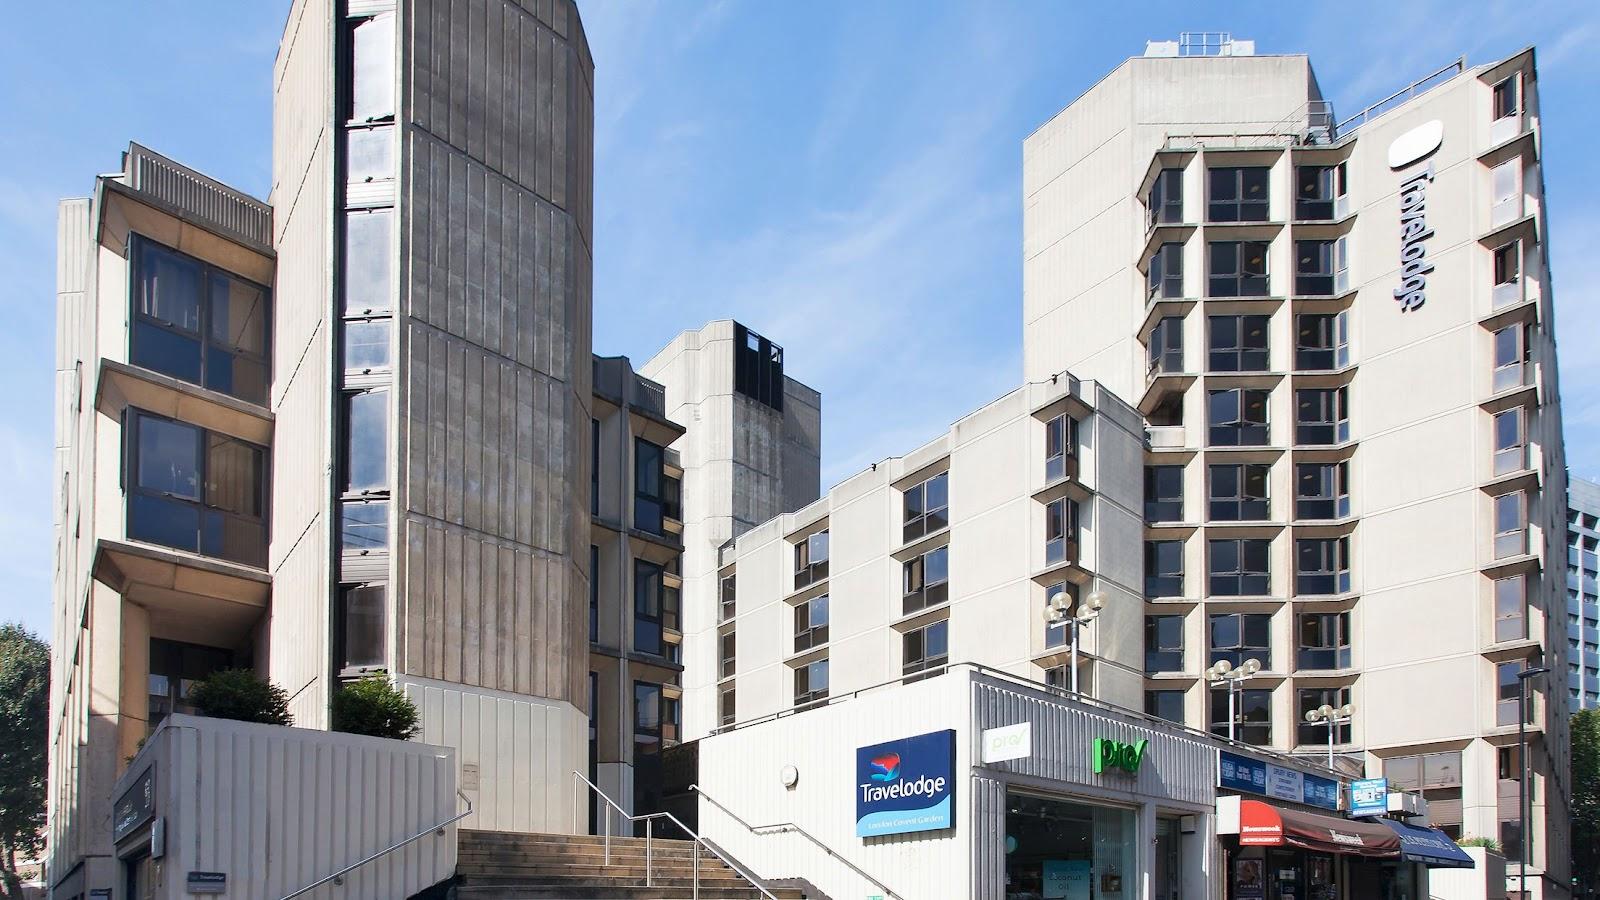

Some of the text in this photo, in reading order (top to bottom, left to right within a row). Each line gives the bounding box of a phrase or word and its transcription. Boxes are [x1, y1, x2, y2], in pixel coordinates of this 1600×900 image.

[1394, 160, 1434, 313] Travelodge
[860, 774, 946, 803] Travelodge
[868, 815, 944, 830] London Covent Garden
